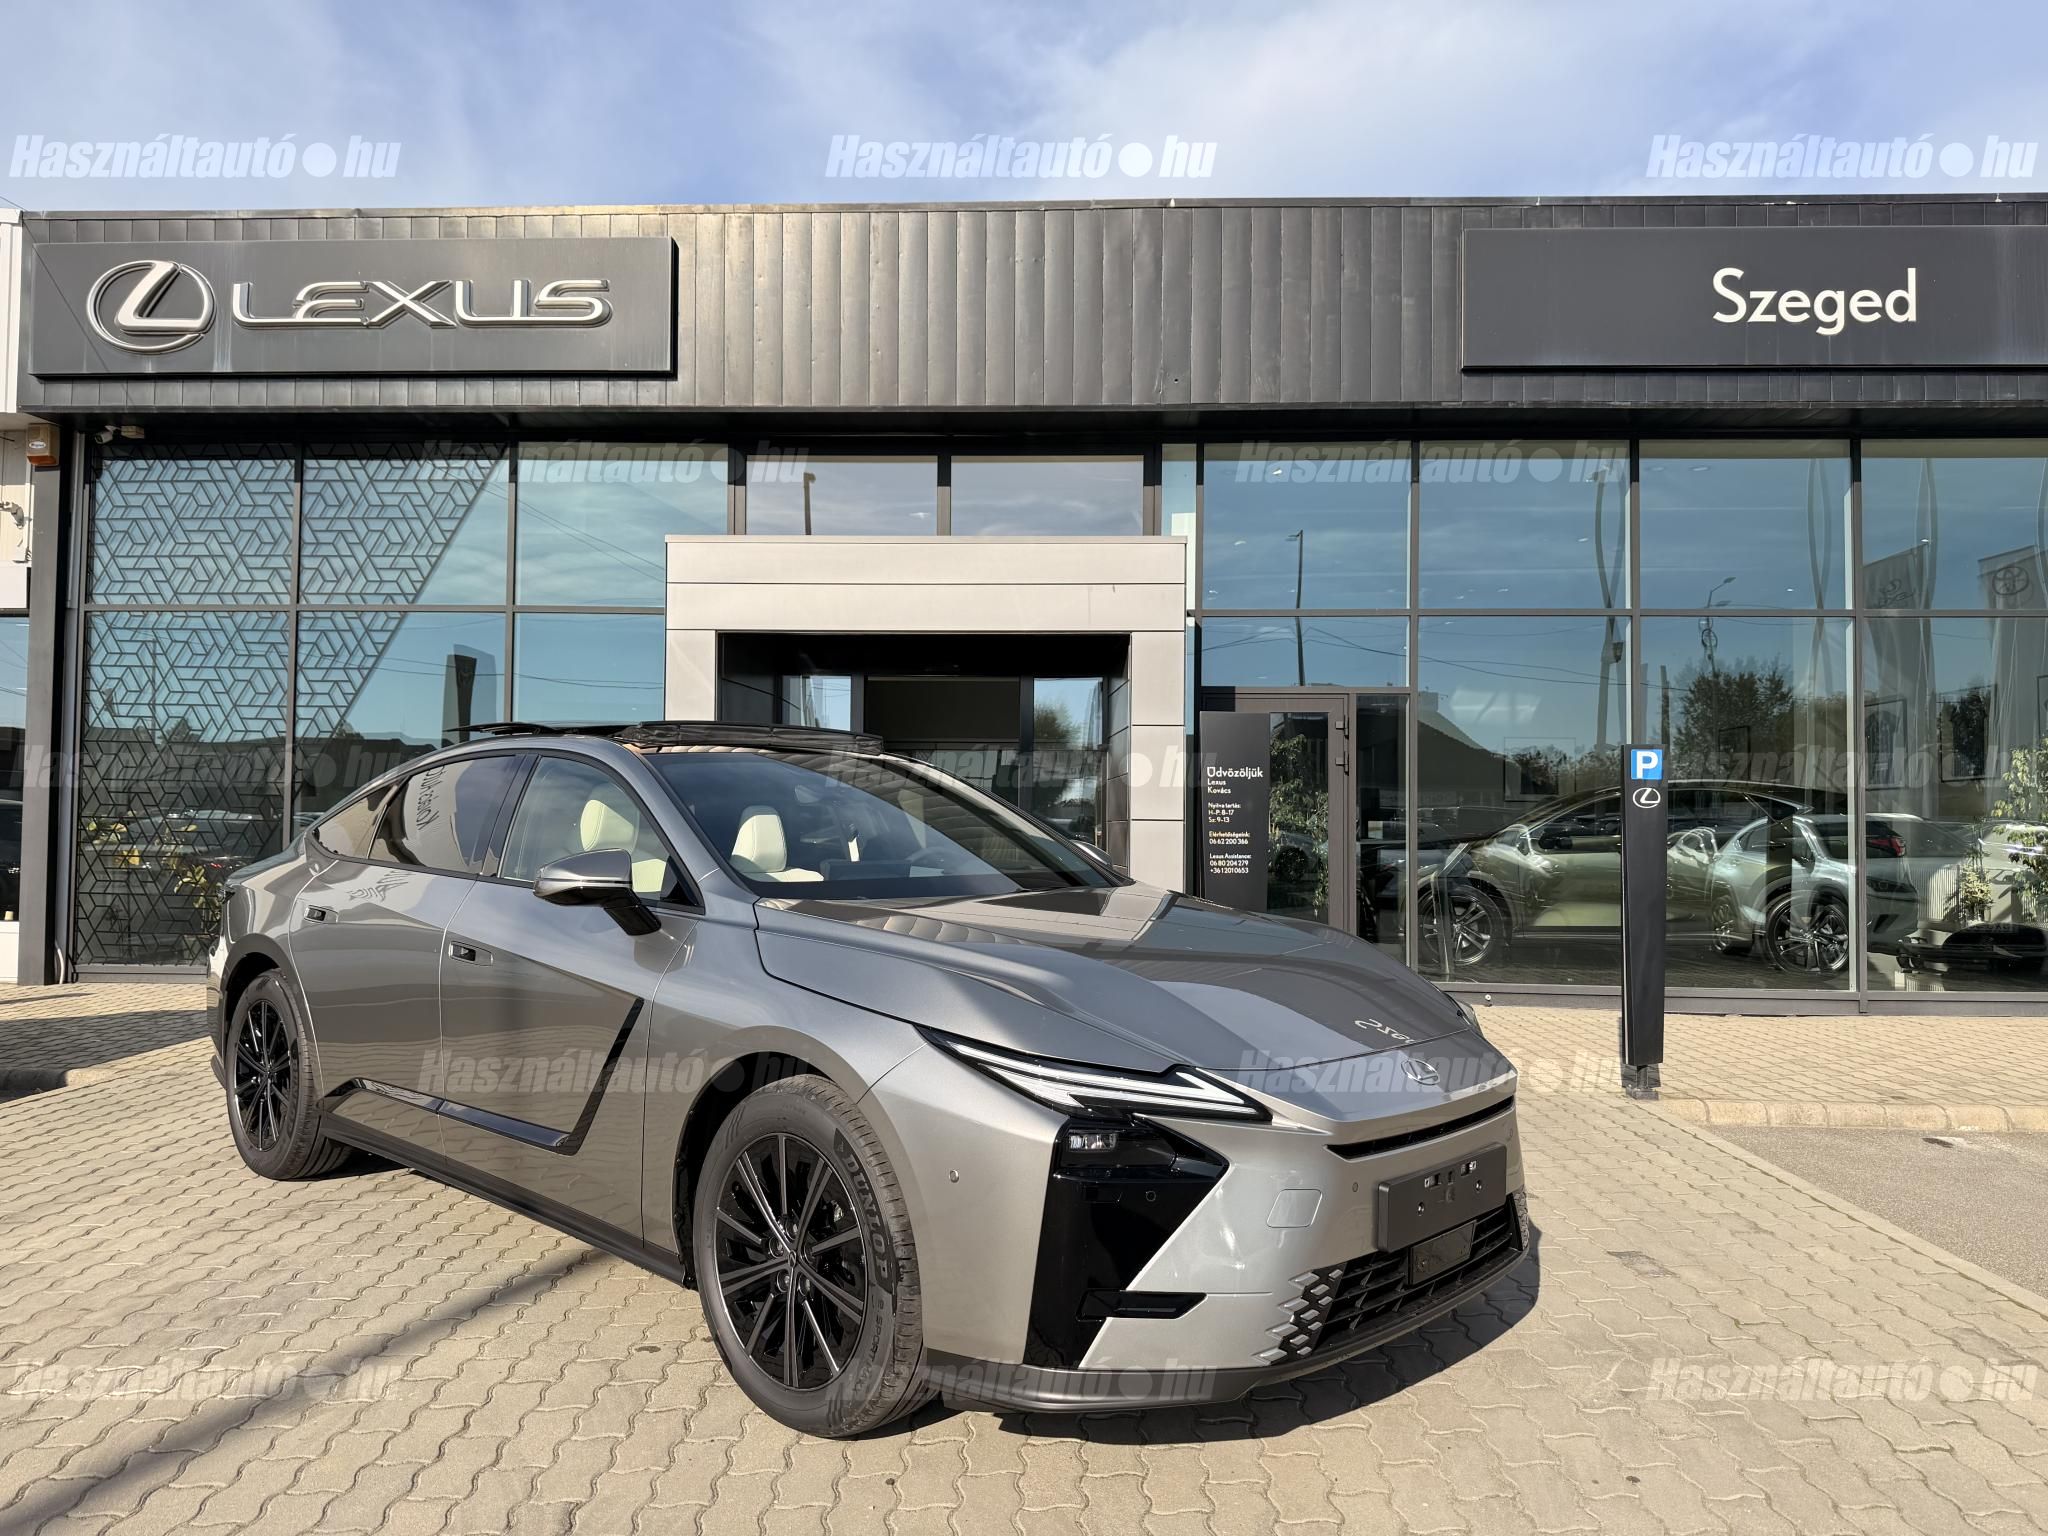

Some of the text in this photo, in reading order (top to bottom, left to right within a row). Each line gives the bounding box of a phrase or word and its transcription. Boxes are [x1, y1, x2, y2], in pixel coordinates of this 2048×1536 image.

[232, 279, 612, 329] LEXUS
[1713, 267, 1917, 336] Szeged
[1206, 766, 1264, 780] Üdvözöljük
[1636, 750, 1659, 779] P
[1207, 777, 1227, 786] Lexus
[1207, 786, 1232, 794] Kovács
[842, 1153, 889, 1280] DUNLOP
